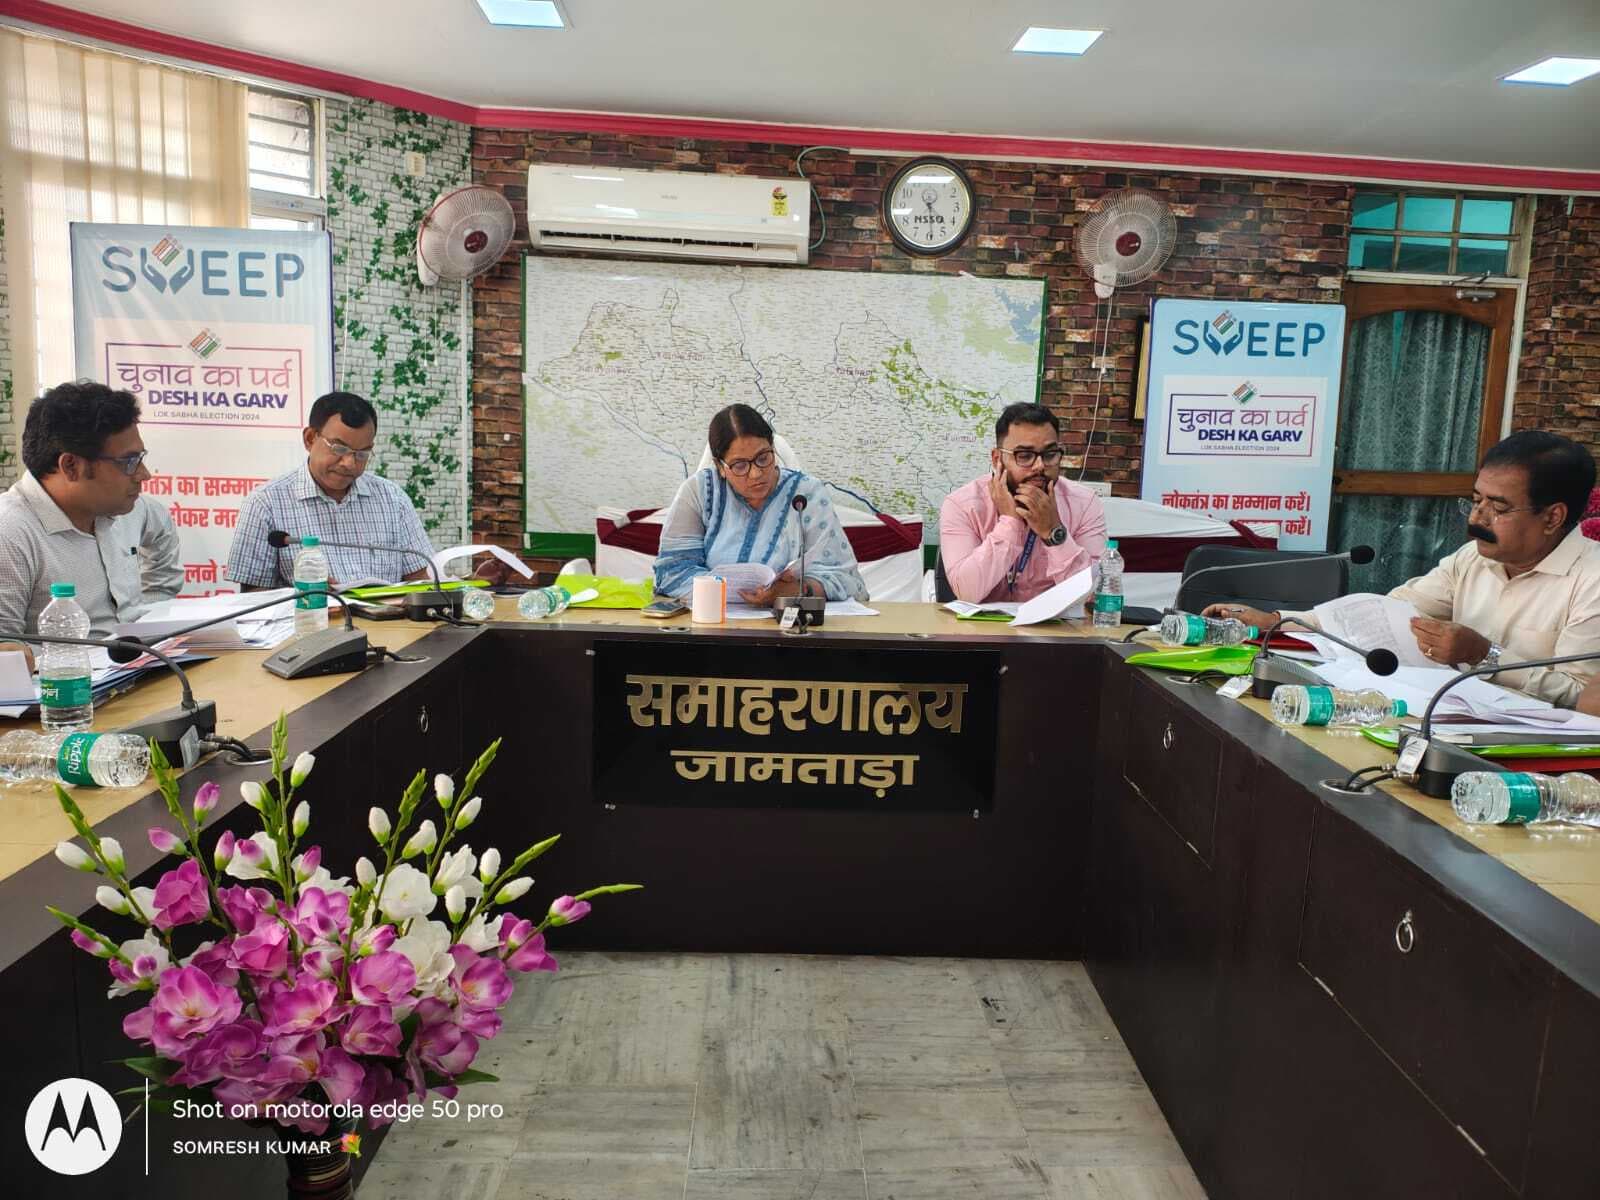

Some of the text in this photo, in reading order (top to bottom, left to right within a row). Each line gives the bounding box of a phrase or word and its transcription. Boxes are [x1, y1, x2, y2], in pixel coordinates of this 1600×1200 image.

[102, 244, 305, 298] SWEEP
[1172, 319, 1326, 357] SWEEP
[116, 359, 292, 393] चुनाव का पर्व
[148, 390, 288, 408] DESH KA GARV
[200, 412, 239, 420] ELECTION
[1177, 403, 1309, 432] चुनाव का पर्व
[1198, 429, 1303, 442] DESH KA GARV
[176, 476, 199, 496] का
[1161, 489, 1209, 510] लोकतंत्र
[1212, 494, 1229, 510] का
[1232, 494, 1282, 511] सम्मान
[626, 674, 968, 736] समाहरणालय
[68, 737, 86, 776] Ripple
[670, 750, 920, 798] जामताड़ा
